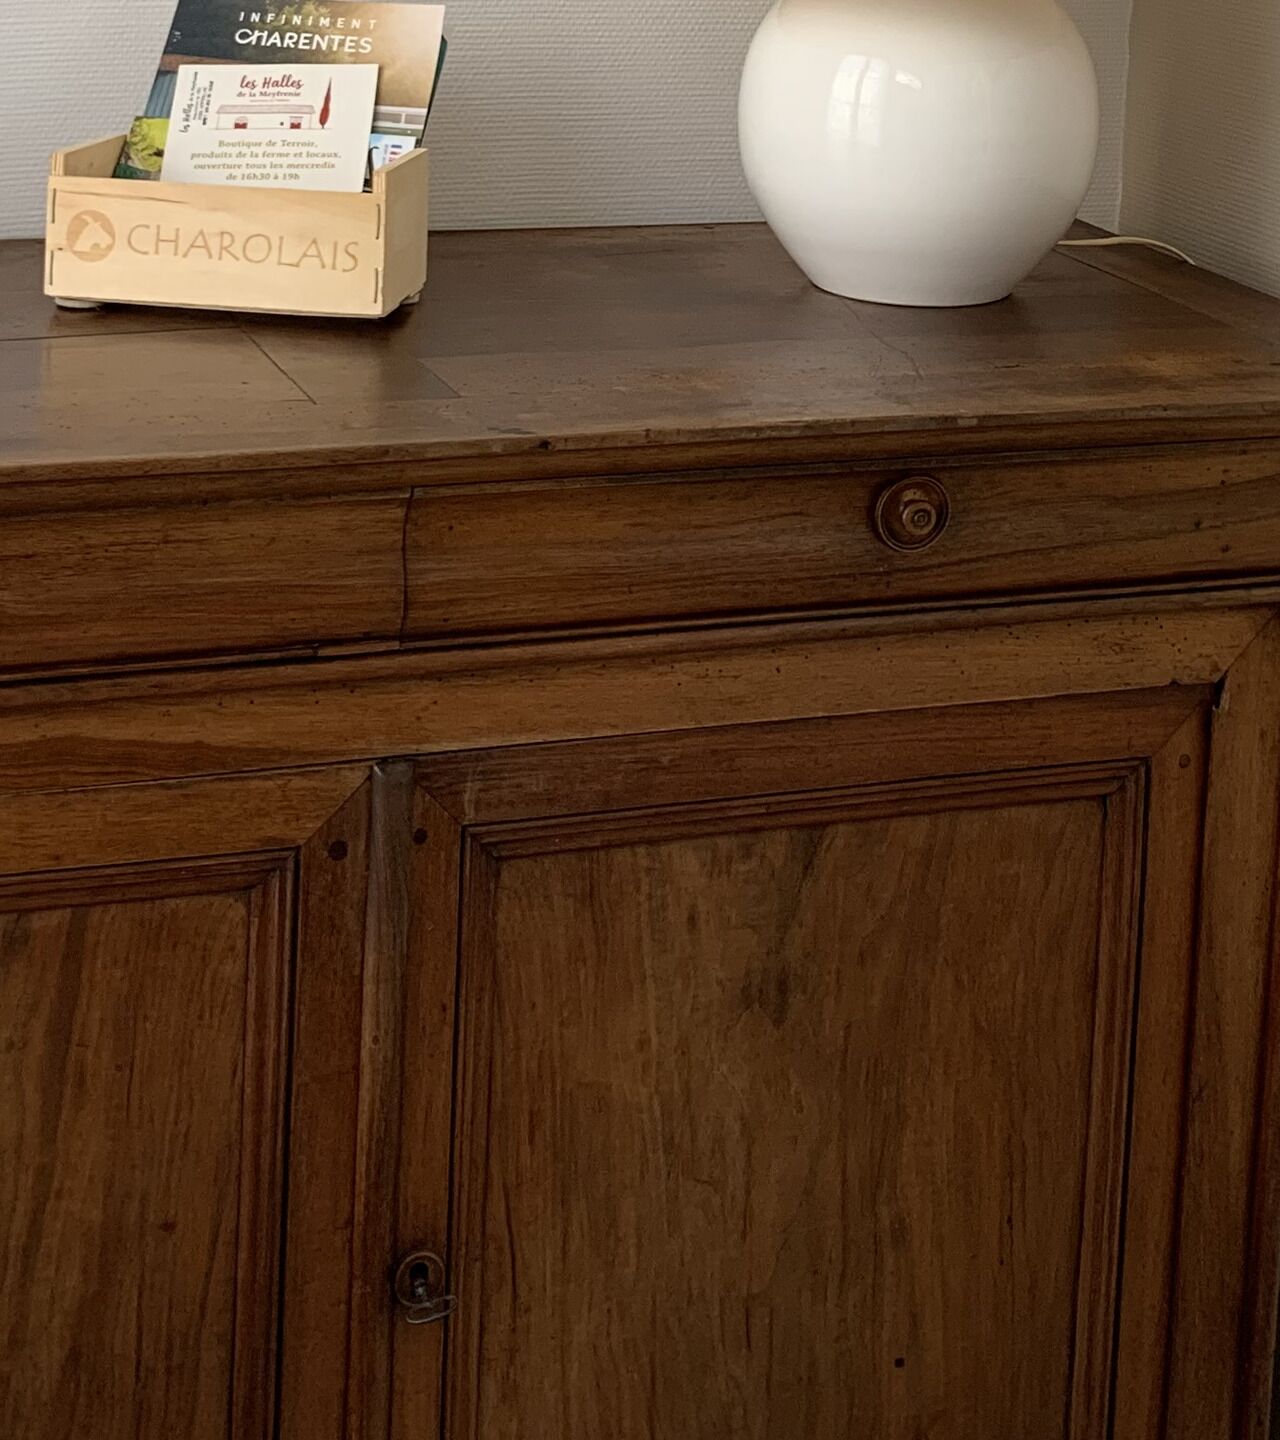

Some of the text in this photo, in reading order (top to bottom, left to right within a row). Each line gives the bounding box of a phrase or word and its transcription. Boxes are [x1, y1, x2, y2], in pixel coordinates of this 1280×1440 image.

[239, 11, 378, 30] INFINIMENT
[234, 28, 373, 54] CHARENTES
[240, 73, 304, 90] les Halles
[218, 139, 262, 149] Boutique
[265, 139, 277, 147] de
[190, 151, 233, 160] produits
[235, 150, 247, 158] de
[250, 150, 259, 158] la
[262, 150, 290, 159] ferme
[193, 161, 336, 170] ouverture tous les mercredis
[226, 172, 238, 181] de
[240, 172, 271, 181] 16h30
[282, 172, 300, 181] 19h
[127, 223, 360, 273] CHAROLAIS
